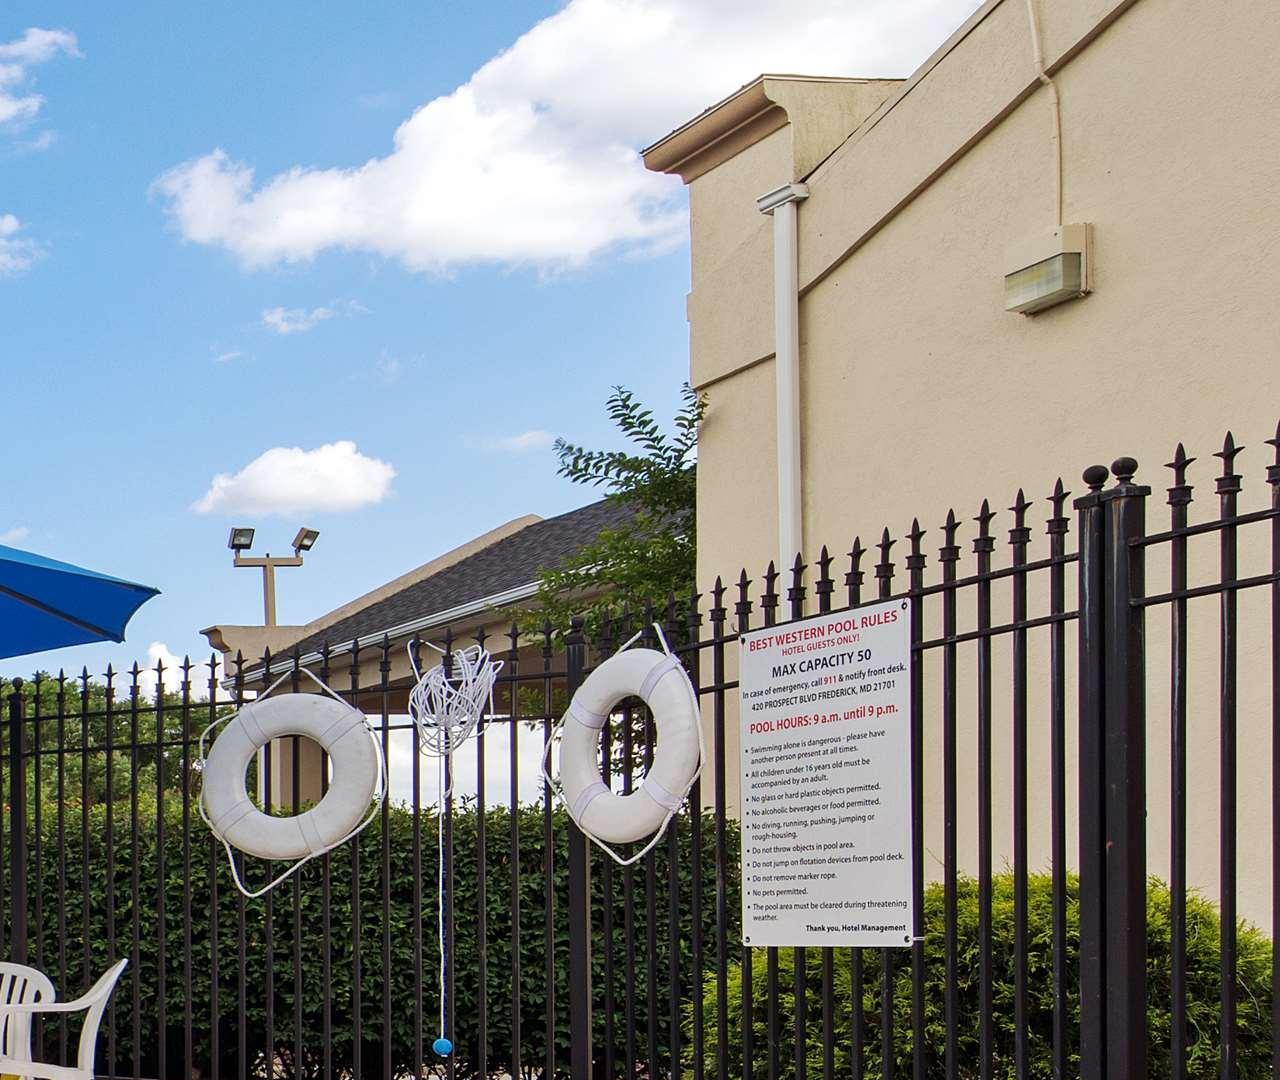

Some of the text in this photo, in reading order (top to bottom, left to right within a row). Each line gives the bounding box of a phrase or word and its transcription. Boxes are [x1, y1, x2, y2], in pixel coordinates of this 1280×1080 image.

[749, 609, 897, 652] BEST WESTERN POOL RULES
[781, 633, 859, 656] HOTEL GUESTS ONLY!
[772, 647, 871, 678] MAX CAPACITY 50
[742, 661, 907, 699] In case of emergency, call 911 & notify front desk.
[751, 679, 895, 711] 420 PROSPECT BLVD FREDERICK, MD 21701
[750, 703, 898, 734] POOL HOURS: 9 a.m. until 9 p.m.
[750, 743, 781, 756] Swimming
[783, 741, 800, 749] alone
[807, 735, 841, 748] dangerous
[846, 731, 867, 742] please
[868, 729, 885, 738] have
[750, 756, 774, 764] another
[775, 754, 796, 762] person
[797, 749, 820, 759] present
[838, 744, 858, 753] times.
[759, 768, 784, 777] children
[785, 765, 803, 774] under
[805, 764, 813, 772] 16
[814, 763, 830, 772] years
[832, 760, 842, 768] old
[843, 758, 860, 767] must
[861, 757, 870, 765] be
[751, 778, 791, 790] accompanied
[792, 777, 799, 785] by
[810, 773, 828, 782] adult.
[761, 794, 776, 803] glass
[784, 791, 799, 799] hard
[800, 789, 820, 799] plastic
[821, 786, 845, 796] objects
[846, 783, 880, 794] permitted.
[761, 806, 788, 815] alcoholic
[789, 803, 820, 814] beverages
[846, 797, 880, 809] permitted.
[792, 843, 814, 853] objects
[823, 842, 837, 851] pool
[860, 923, 905, 932] Management
